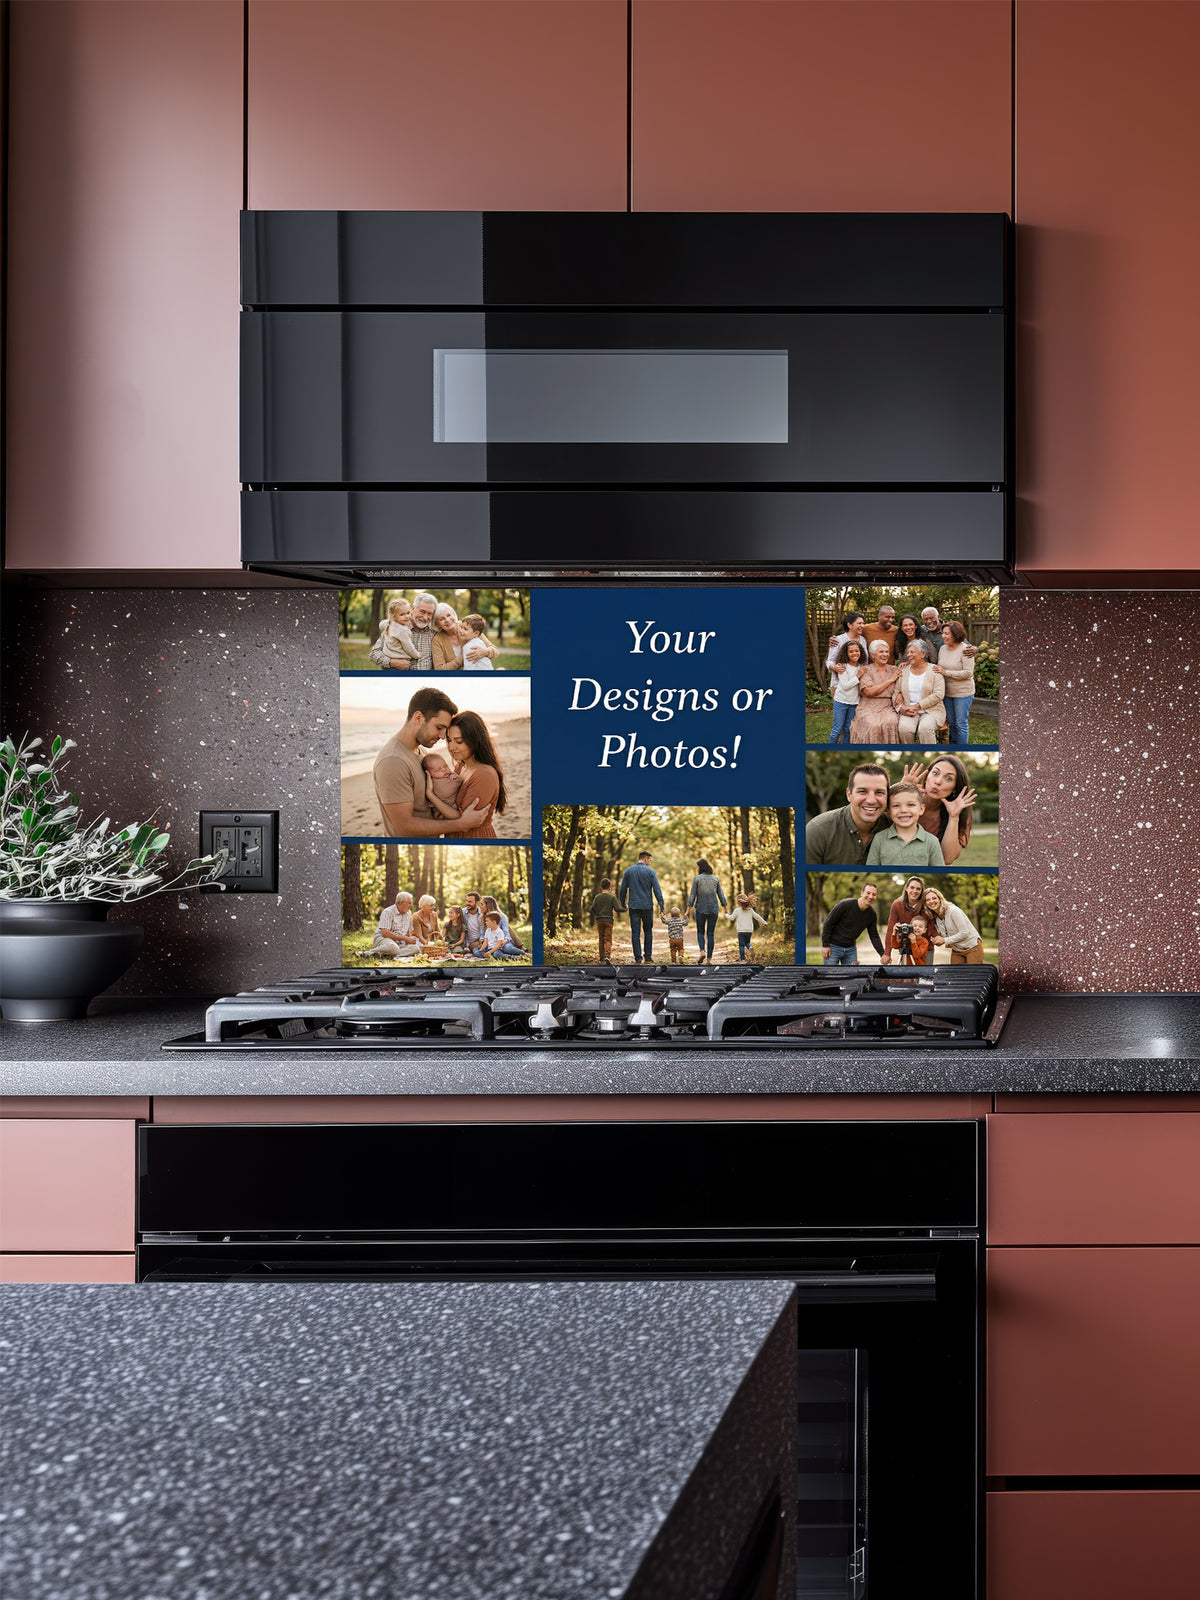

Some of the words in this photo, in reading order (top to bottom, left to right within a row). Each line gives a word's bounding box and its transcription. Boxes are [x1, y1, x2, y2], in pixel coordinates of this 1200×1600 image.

[625, 620, 716, 654] Your
[567, 677, 719, 722] Designs
[731, 688, 773, 711] or
[597, 732, 742, 769] Photos!
